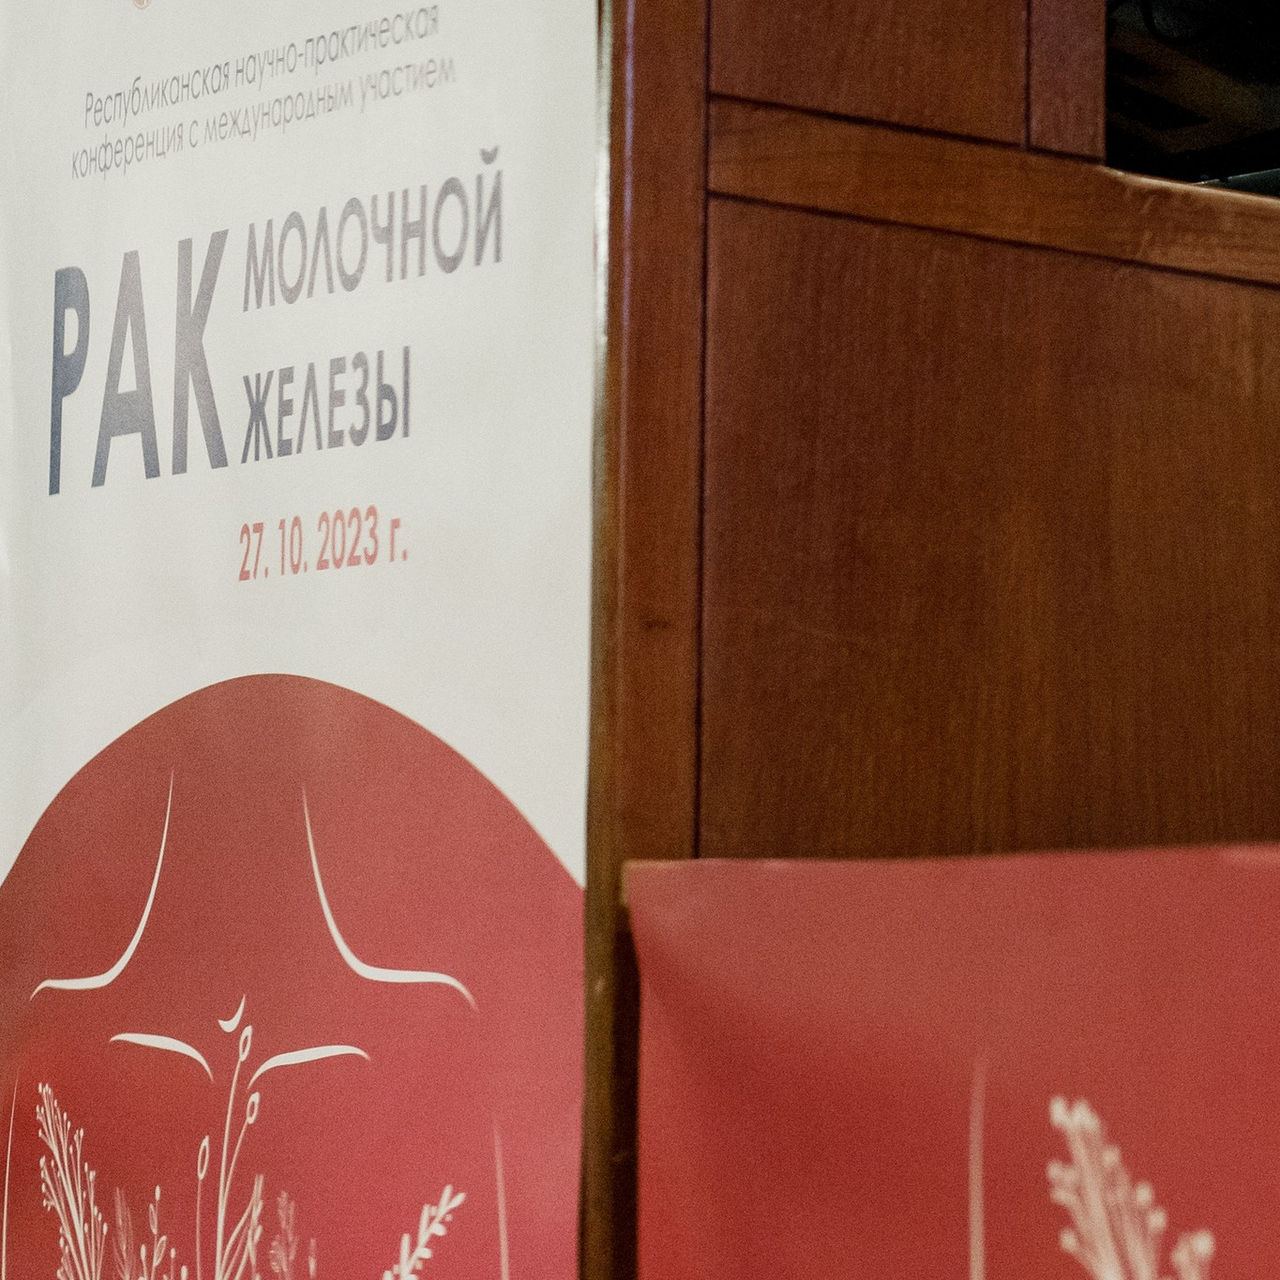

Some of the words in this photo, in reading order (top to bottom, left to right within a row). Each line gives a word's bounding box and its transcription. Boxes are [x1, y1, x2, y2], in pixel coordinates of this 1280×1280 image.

[71, 122, 184, 181] конференция
[188, 119, 199, 149] с
[203, 79, 355, 145] международным
[359, 56, 457, 114] участием
[84, 60, 230, 129] Республиканская
[234, 4, 440, 92] научно-практическая
[241, 147, 504, 313] МОЛОЧНОЙ
[48, 228, 230, 496] РАК
[240, 345, 412, 464] ЖЕЛЕЗЫ
[389, 517, 408, 562] г.
